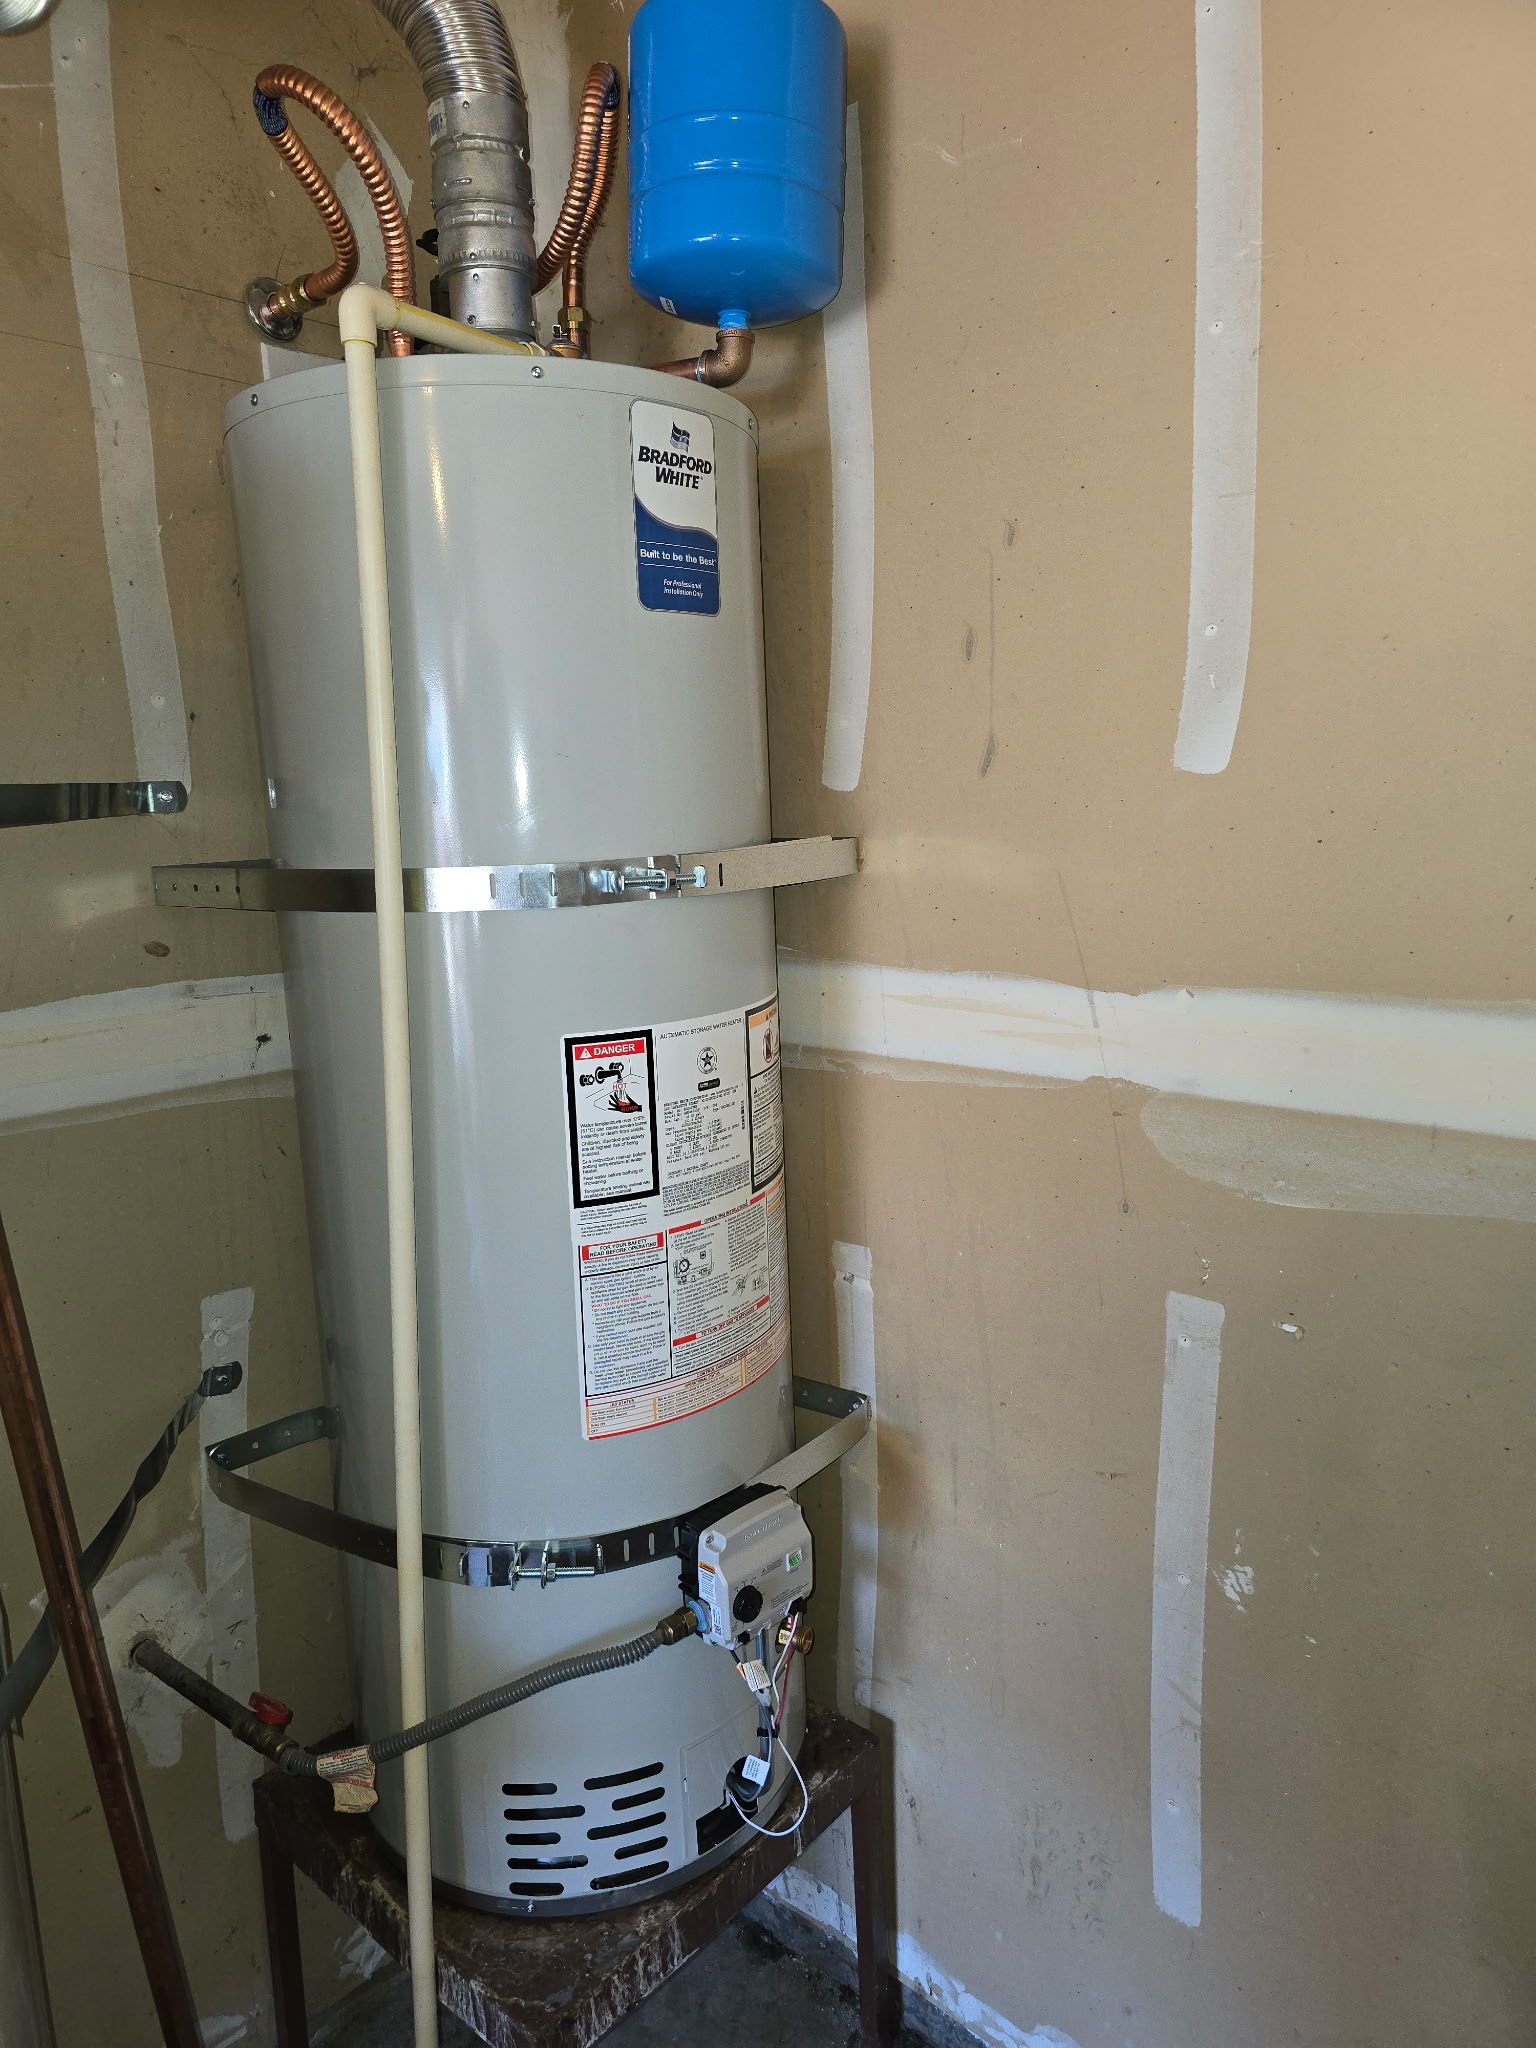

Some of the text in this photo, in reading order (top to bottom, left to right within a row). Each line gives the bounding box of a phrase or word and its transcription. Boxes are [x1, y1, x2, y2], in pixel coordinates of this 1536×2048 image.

[638, 445, 712, 474] BRADFORD
[640, 548, 660, 559] Built
[662, 552, 671, 560] to
[672, 552, 683, 561] be
[686, 554, 698, 564] the
[672, 580, 702, 589] Professional
[664, 587, 693, 596] Installation
[691, 1025, 713, 1035] STORAGE
[713, 1022, 727, 1030] WATER
[594, 1044, 635, 1056] DANGER
[606, 1247, 627, 1255] BEFORE
